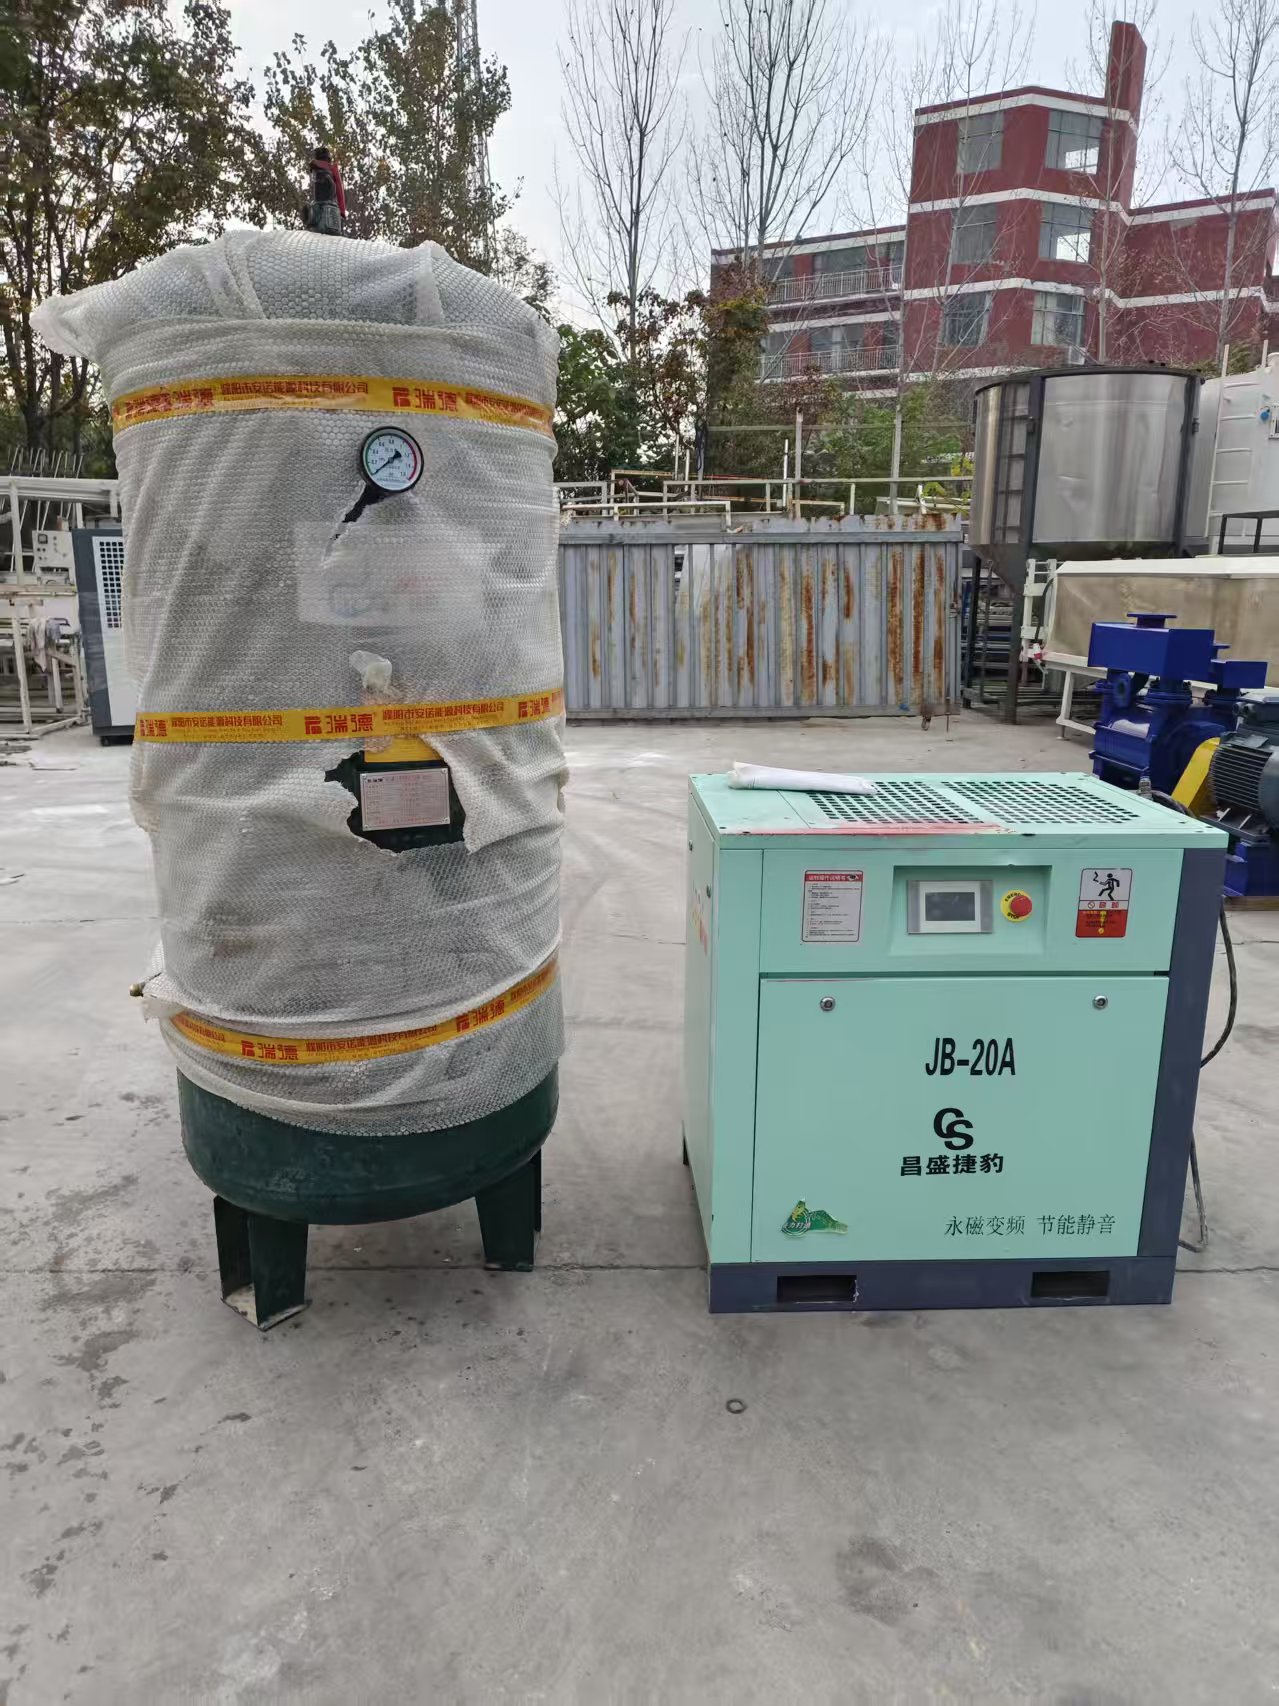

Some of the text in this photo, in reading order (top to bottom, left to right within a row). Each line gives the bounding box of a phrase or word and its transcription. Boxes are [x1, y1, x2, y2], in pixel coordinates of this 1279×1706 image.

[325, 713, 374, 734] 瑞德
[257, 1042, 299, 1061] 瑞德
[925, 1037, 1016, 1076] JB-20A
[933, 1107, 974, 1151] CS
[900, 1153, 1005, 1177] 昌盛捷豹
[944, 1213, 1116, 1237] 永磁变频 节能静音
